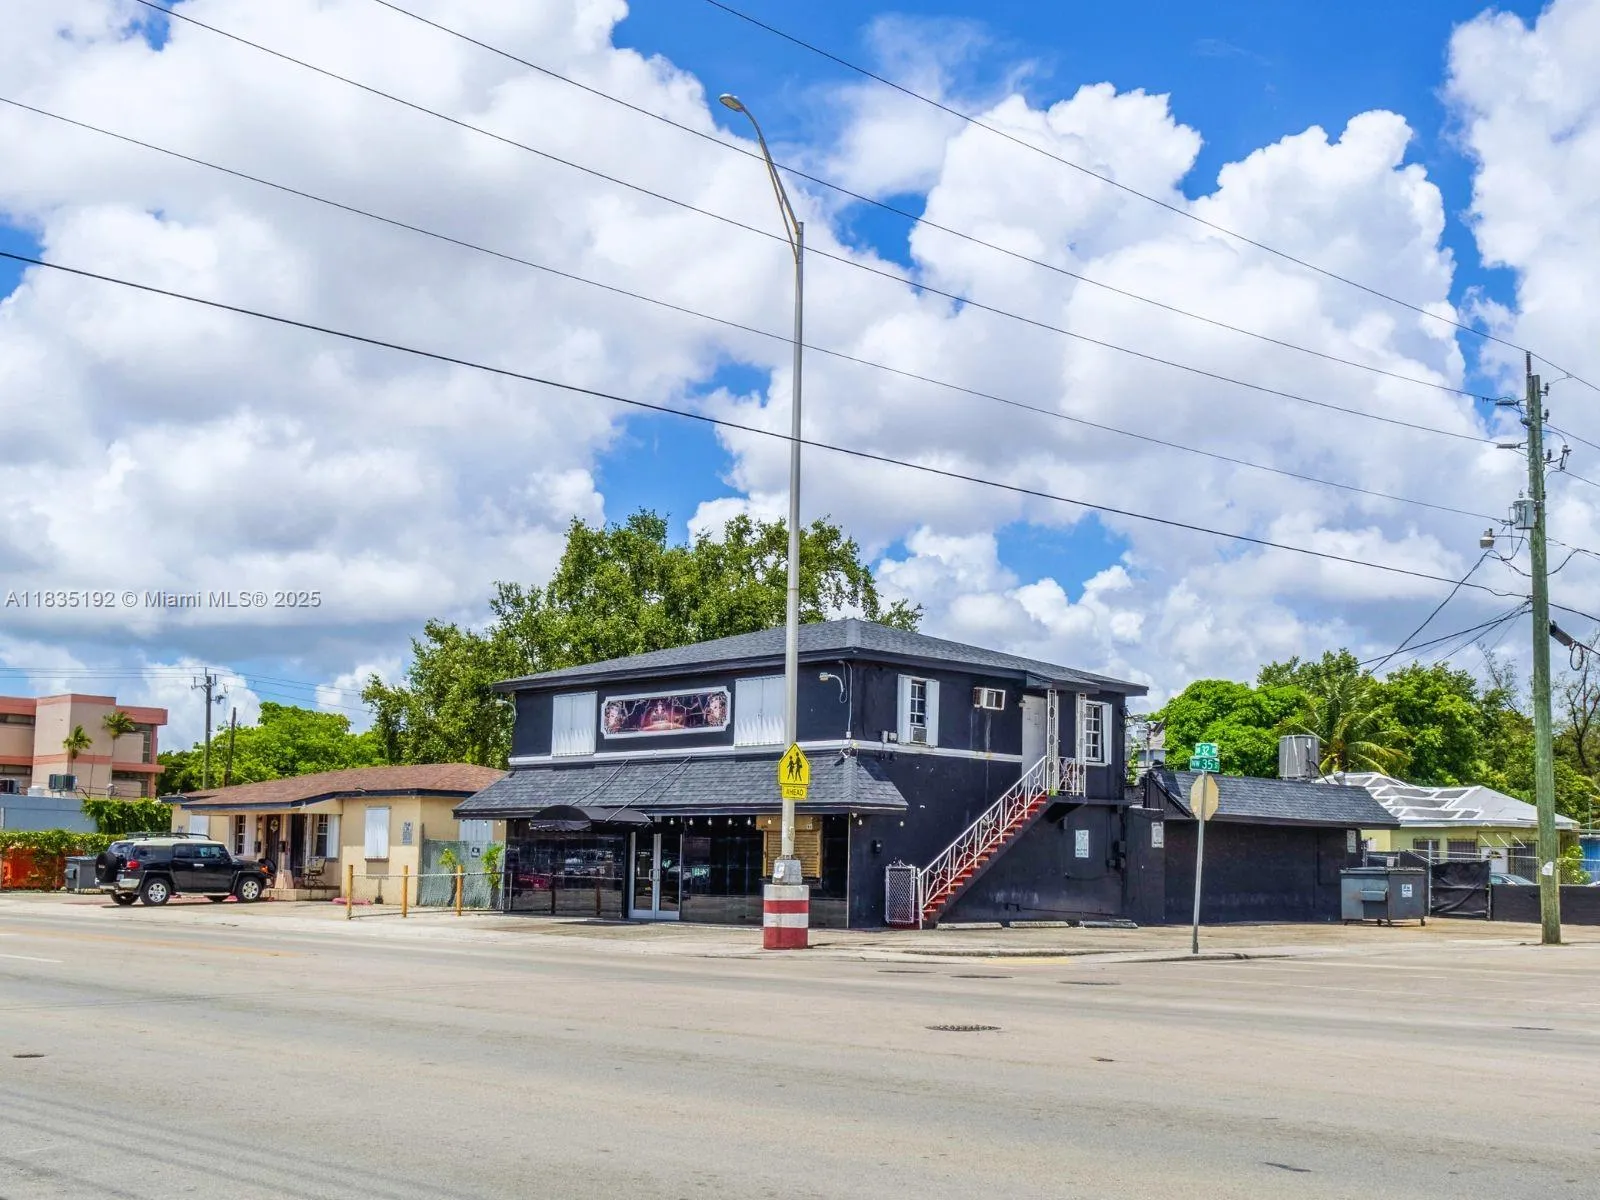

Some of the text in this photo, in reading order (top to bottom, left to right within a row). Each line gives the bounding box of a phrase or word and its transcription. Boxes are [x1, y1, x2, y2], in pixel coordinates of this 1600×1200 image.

[1201, 745, 1210, 756] 32
[1201, 758, 1213, 770] 35
[785, 788, 804, 796] AHEAD
